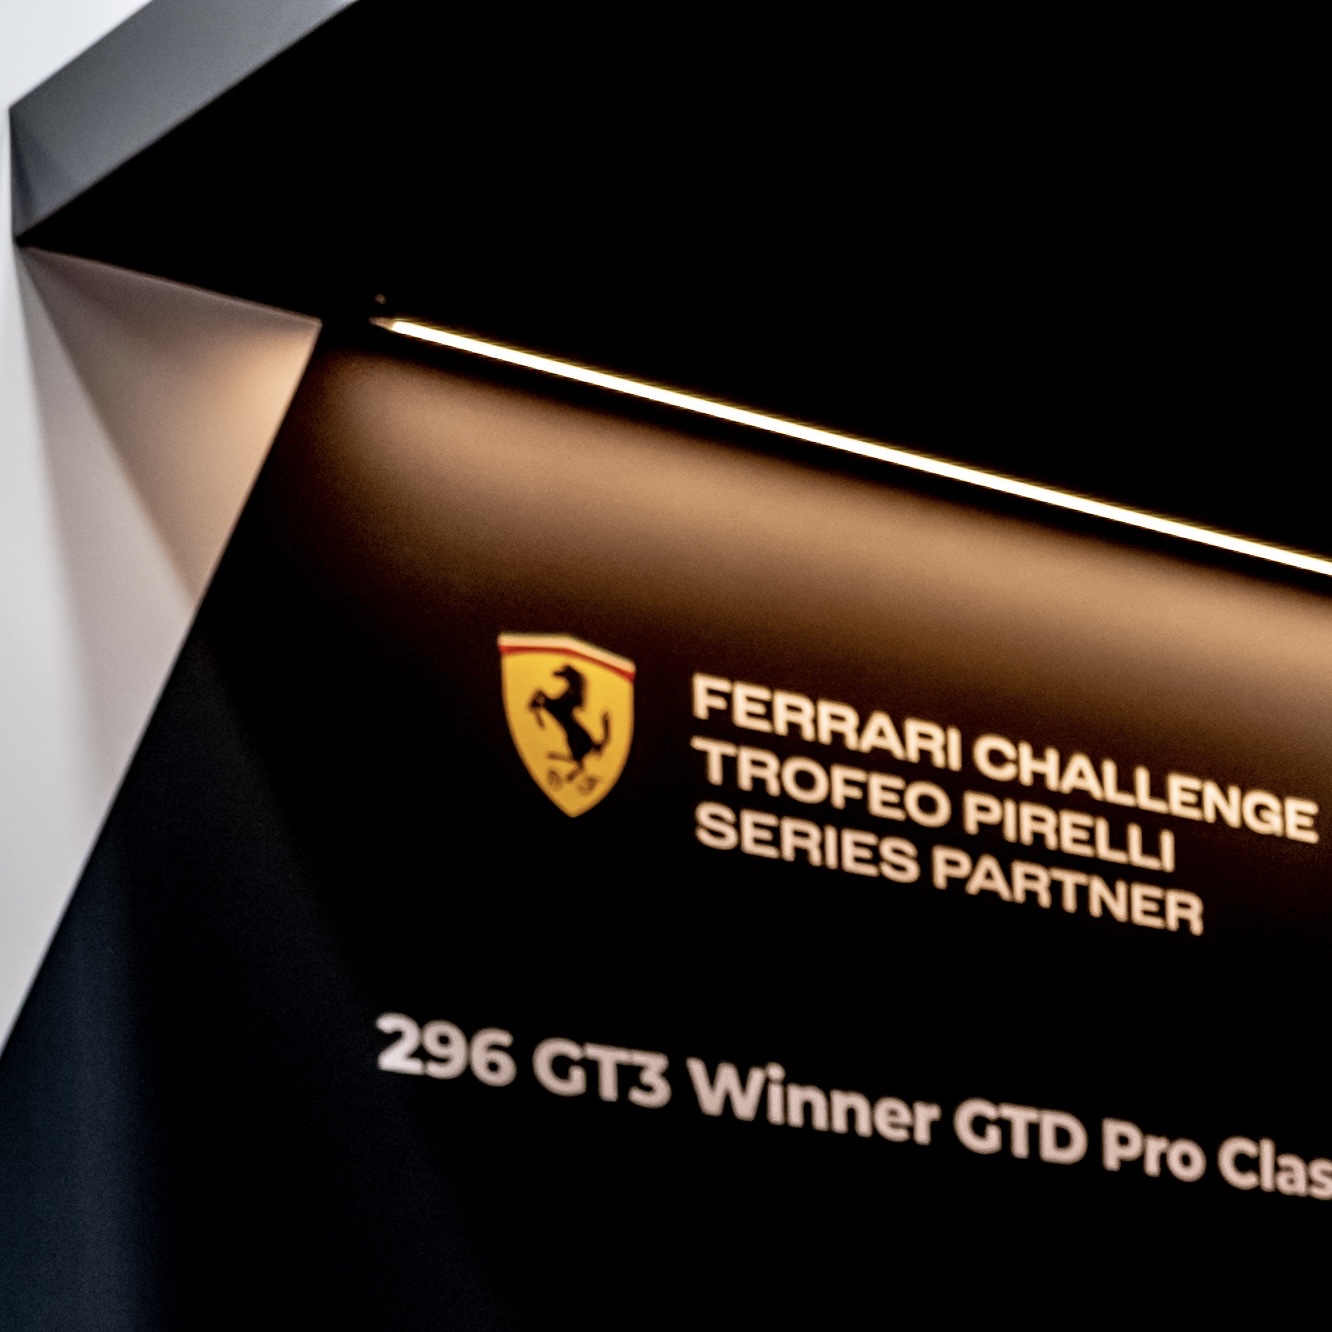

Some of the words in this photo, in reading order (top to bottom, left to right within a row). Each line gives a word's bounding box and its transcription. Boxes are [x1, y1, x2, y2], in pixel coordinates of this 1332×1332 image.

[693, 738, 949, 825] TROFEO
[965, 794, 1173, 871] PIRELLI
[694, 675, 960, 770] FERRARI
[975, 737, 1318, 843] CHALLENGE
[697, 804, 918, 881] SERIES
[934, 848, 1202, 934] PARTNER
[376, 1014, 515, 1085] 296
[534, 1039, 670, 1106] GT3
[688, 1059, 939, 1144] Winner
[955, 1100, 1086, 1162] GTD
[1104, 1120, 1205, 1181] Pro
